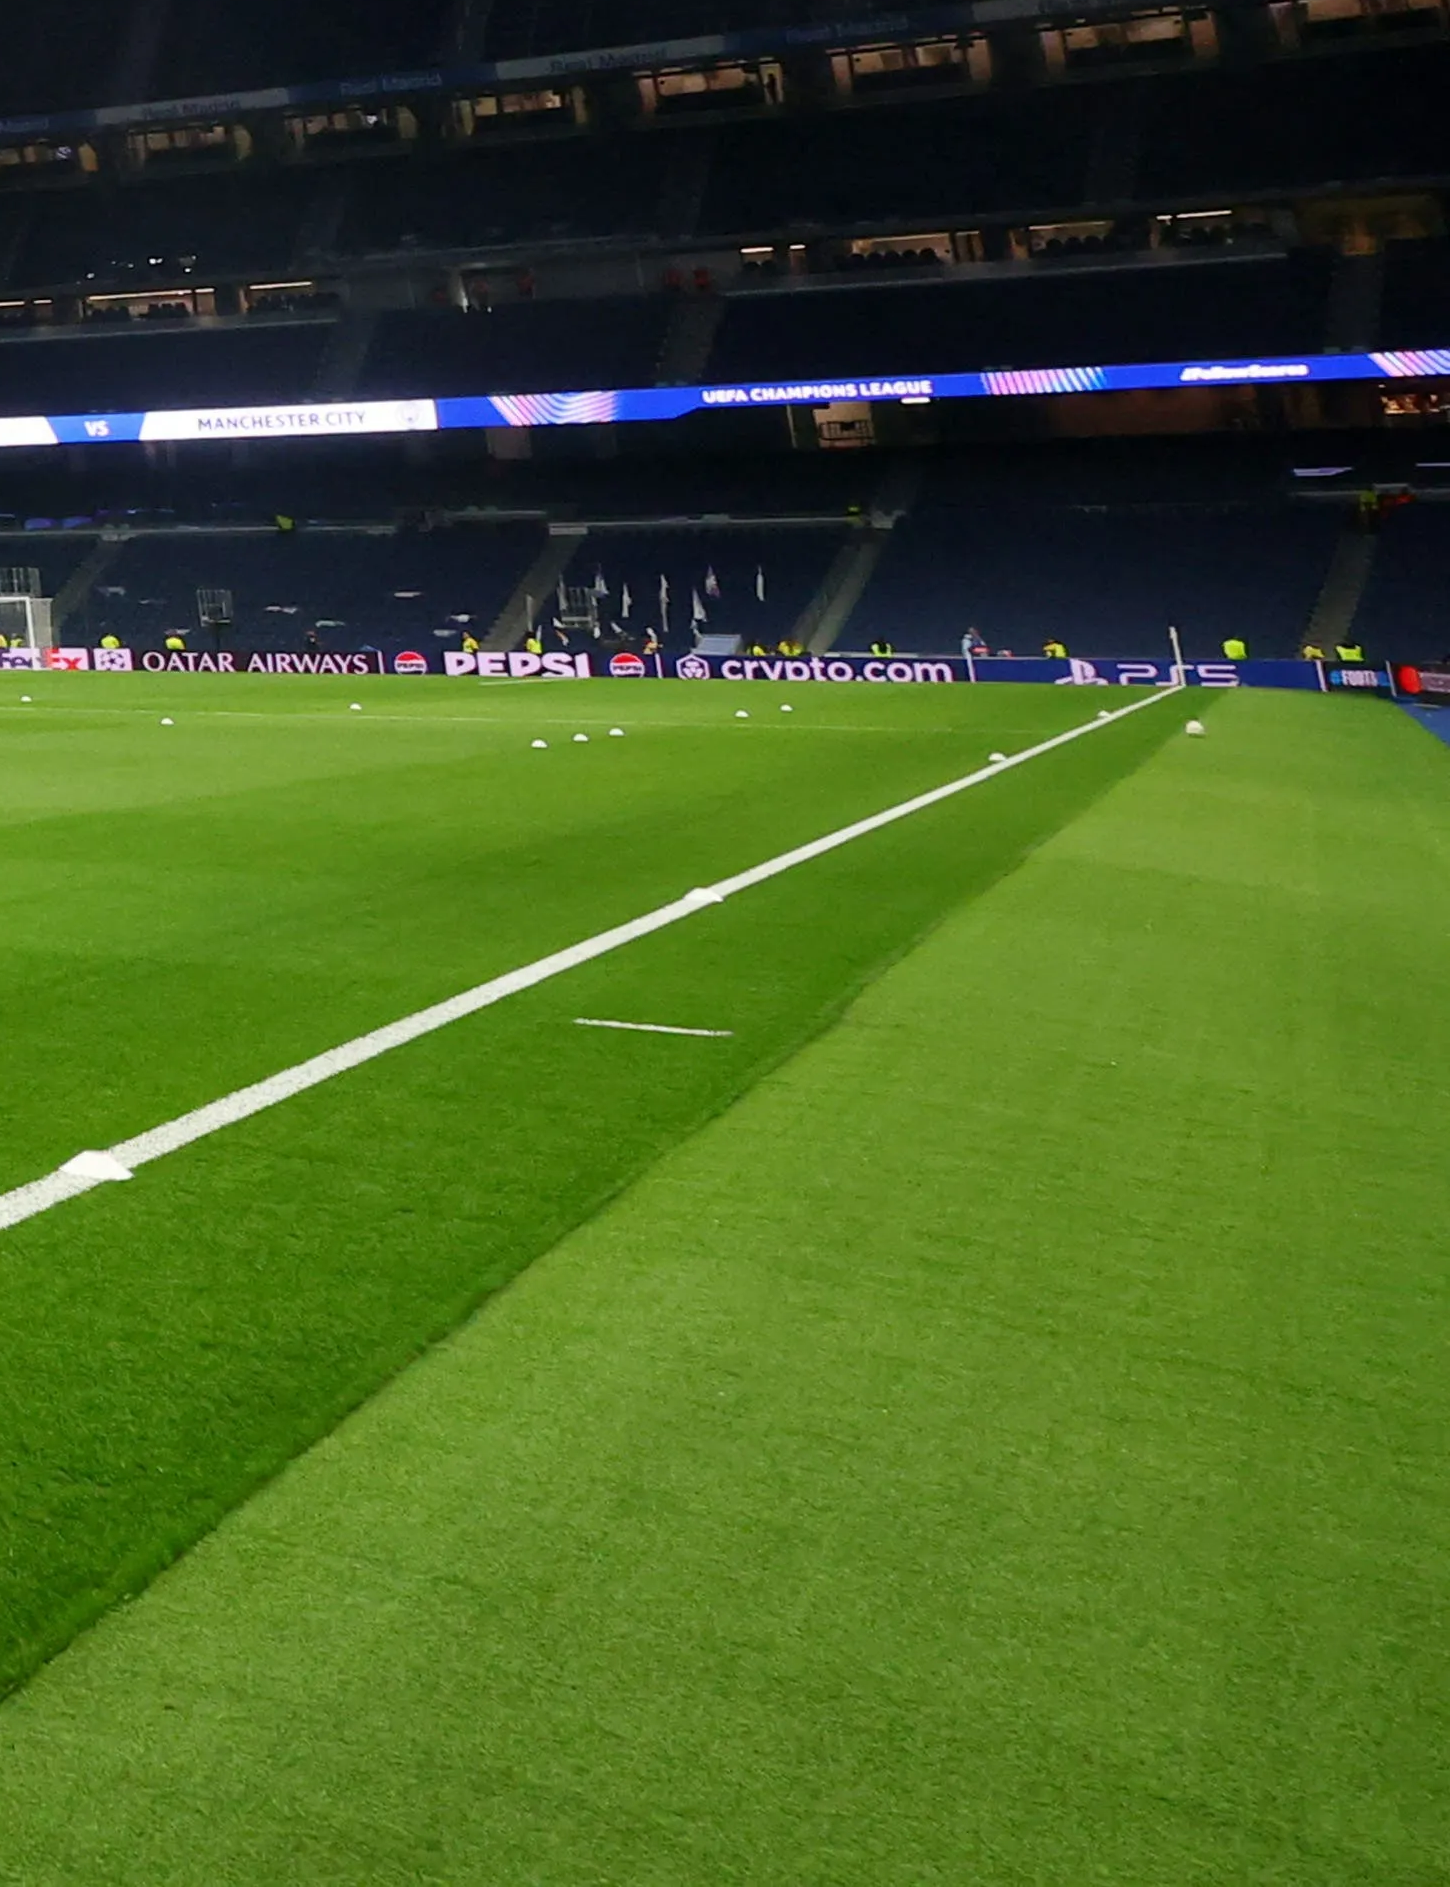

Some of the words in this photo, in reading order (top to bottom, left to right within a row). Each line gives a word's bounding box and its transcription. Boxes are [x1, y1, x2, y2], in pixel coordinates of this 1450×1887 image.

[702, 389, 748, 405] UEFA
[749, 383, 857, 403] CHAMPIONS
[859, 380, 933, 397] LEAGUE
[84, 419, 110, 437] VS
[197, 412, 320, 432] MANCHESTER
[325, 401, 366, 424] CITY
[142, 651, 234, 672] QATAR
[247, 652, 370, 674] AIRWAYS
[444, 651, 591, 677] PEPSI
[721, 656, 953, 683] crypto.com
[1116, 662, 1239, 688] PS5
